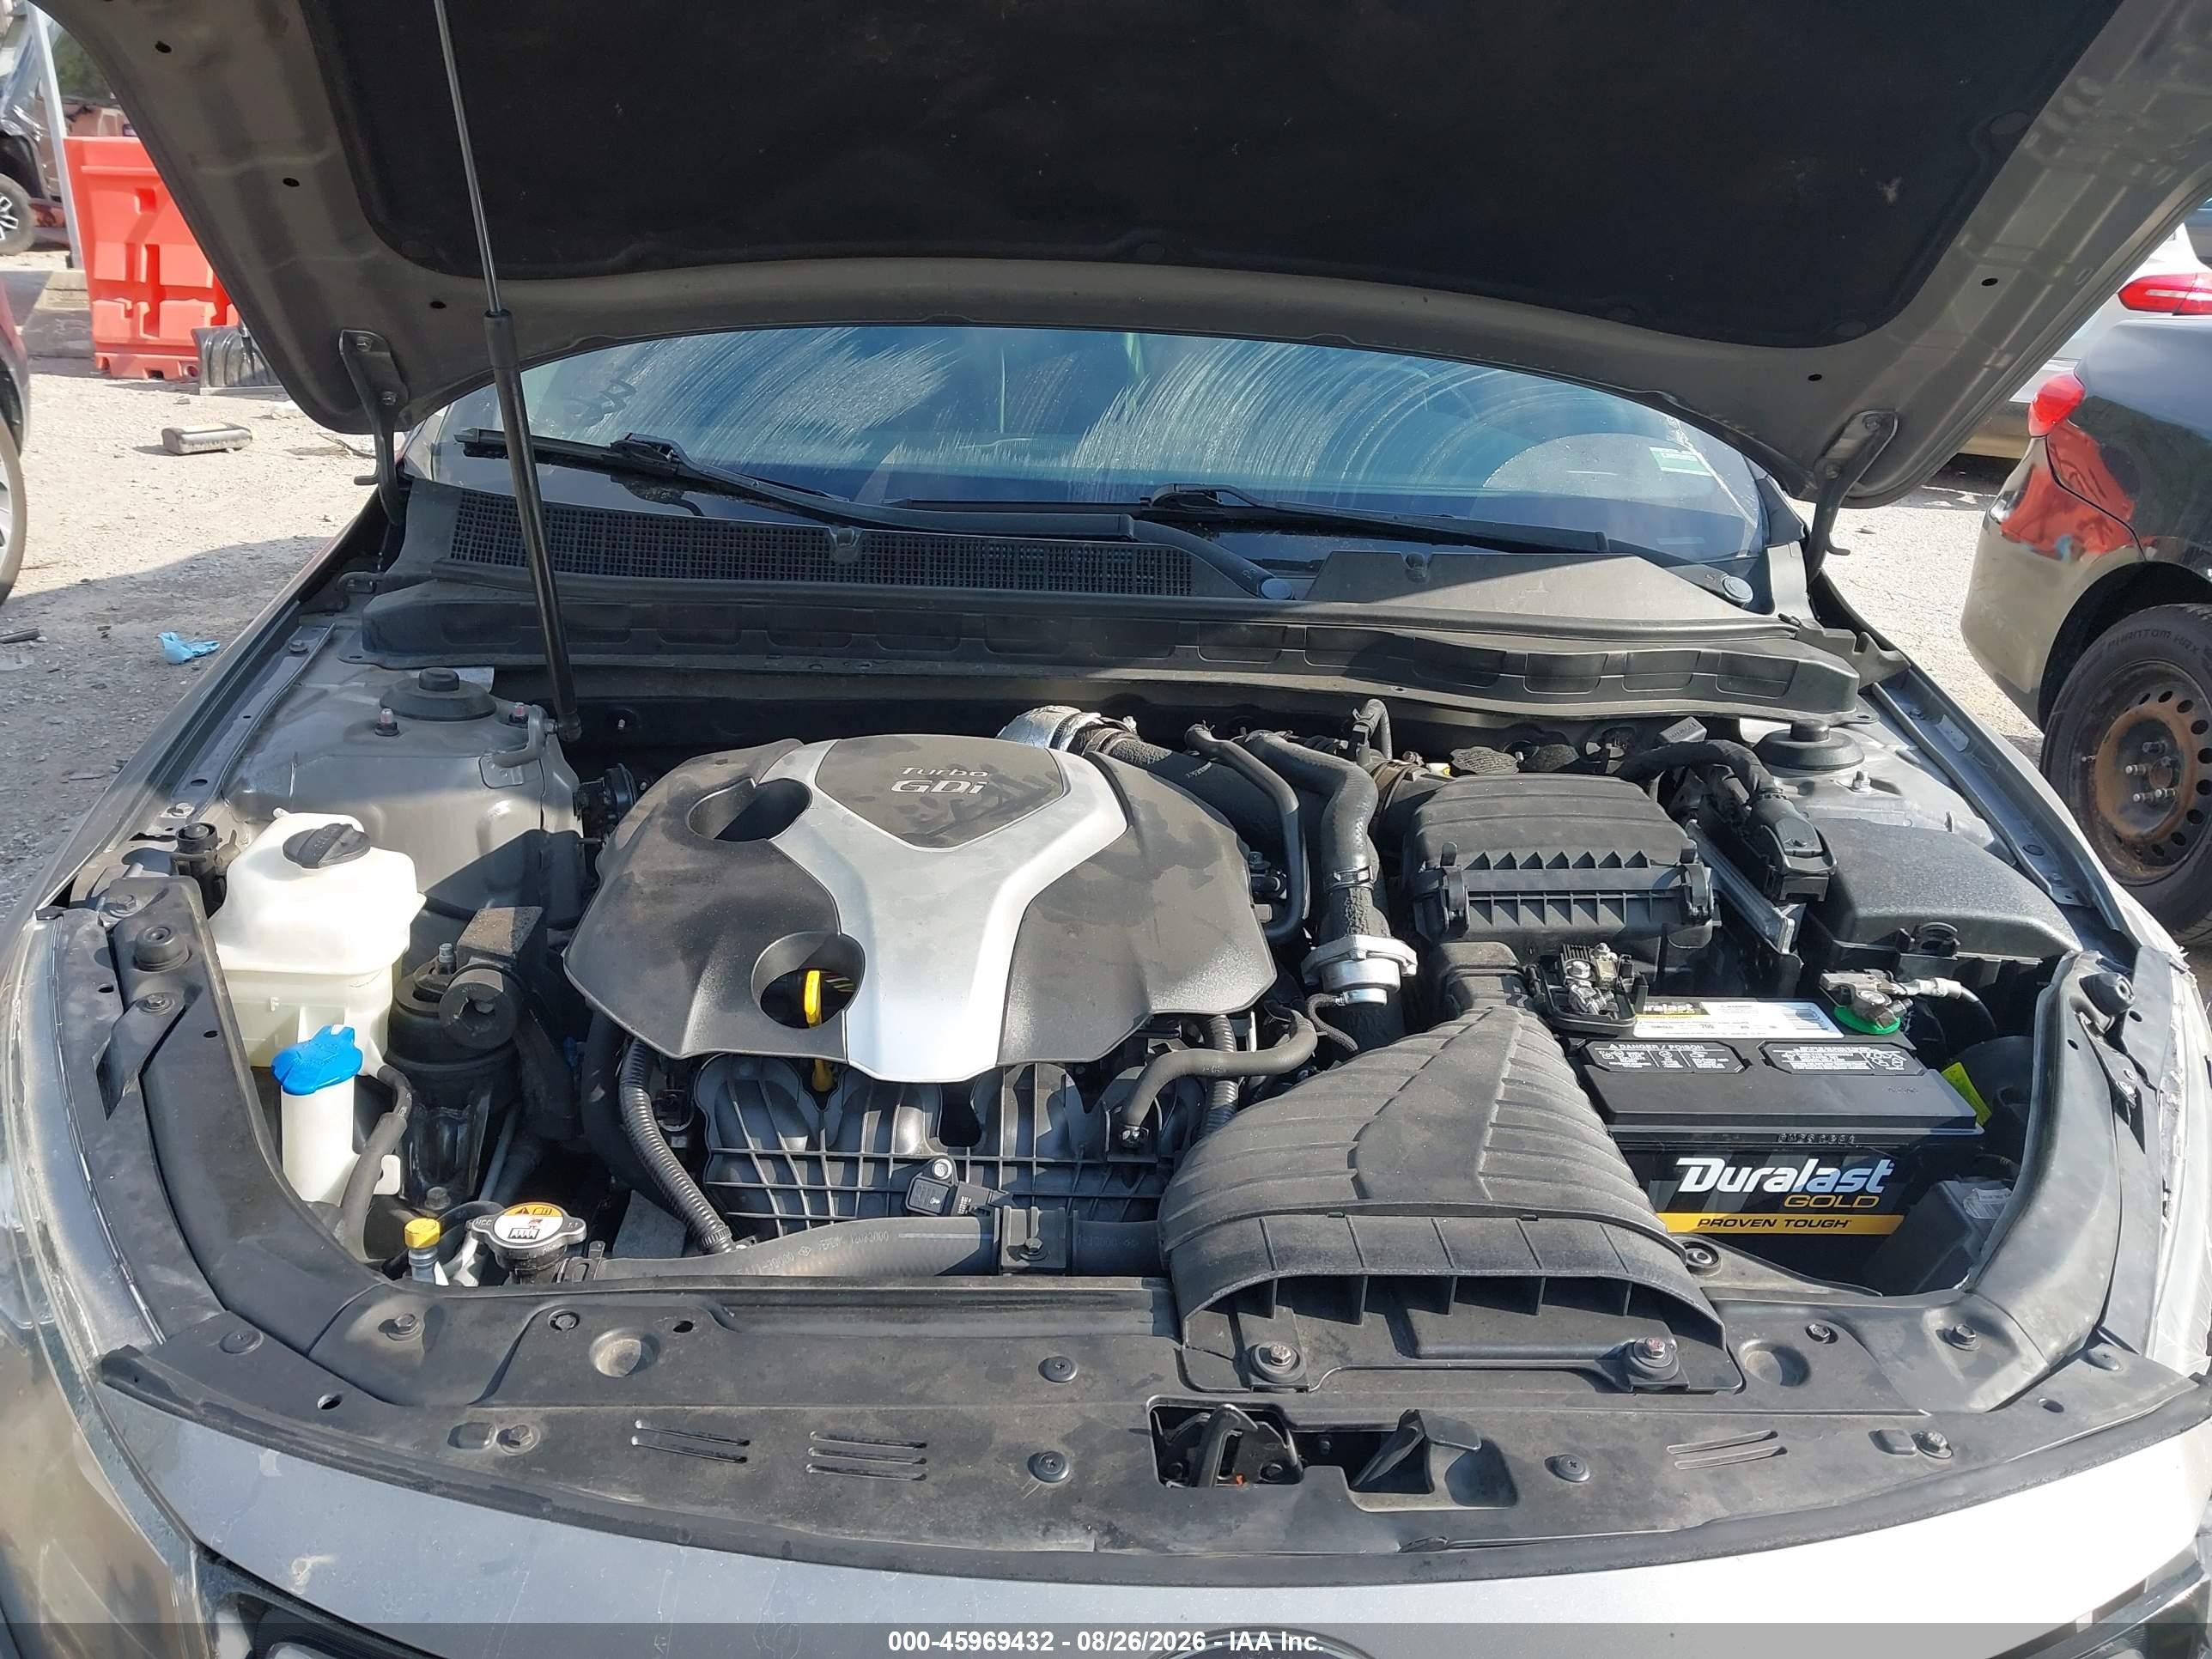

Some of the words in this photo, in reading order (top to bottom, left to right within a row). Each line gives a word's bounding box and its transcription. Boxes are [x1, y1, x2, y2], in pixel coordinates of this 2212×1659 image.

[900, 767, 989, 777] Turbo
[890, 780, 988, 795] GDi
[1784, 1194, 1880, 1208] GOLD
[1697, 1218, 1778, 1228] PROVEN
[1784, 1219, 1849, 1228] TOUGH
